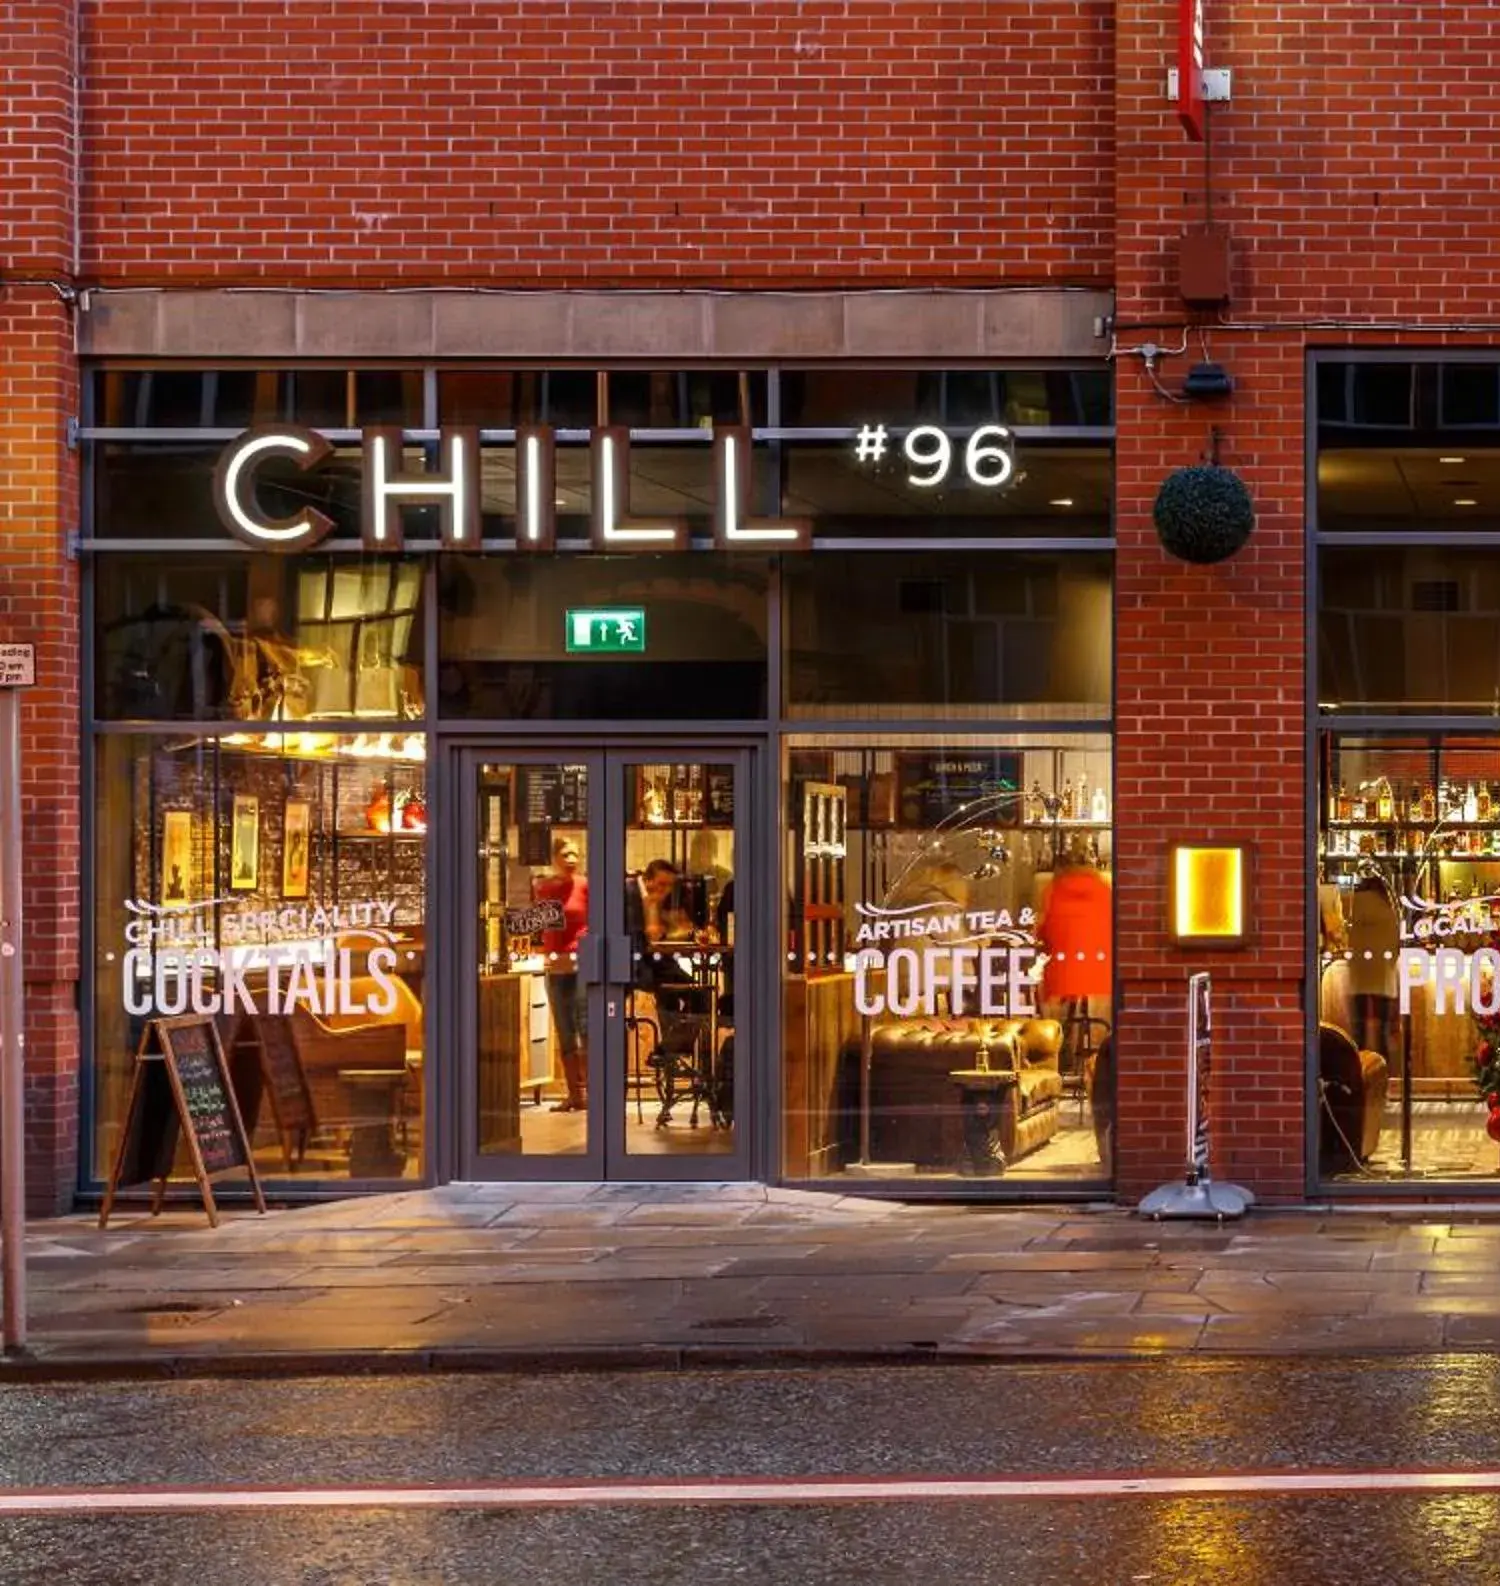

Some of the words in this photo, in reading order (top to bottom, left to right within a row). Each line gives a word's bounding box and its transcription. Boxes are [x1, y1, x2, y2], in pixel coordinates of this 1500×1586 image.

[215, 425, 810, 550] CHILL
[124, 914, 211, 944] CHILL
[222, 901, 398, 936] SPECIALITY
[856, 914, 961, 942] ARTISAN
[966, 908, 1013, 931] TEA
[1019, 906, 1036, 926] &
[123, 947, 398, 1015] COCKTAILS
[855, 947, 1037, 1016] COFFEE
